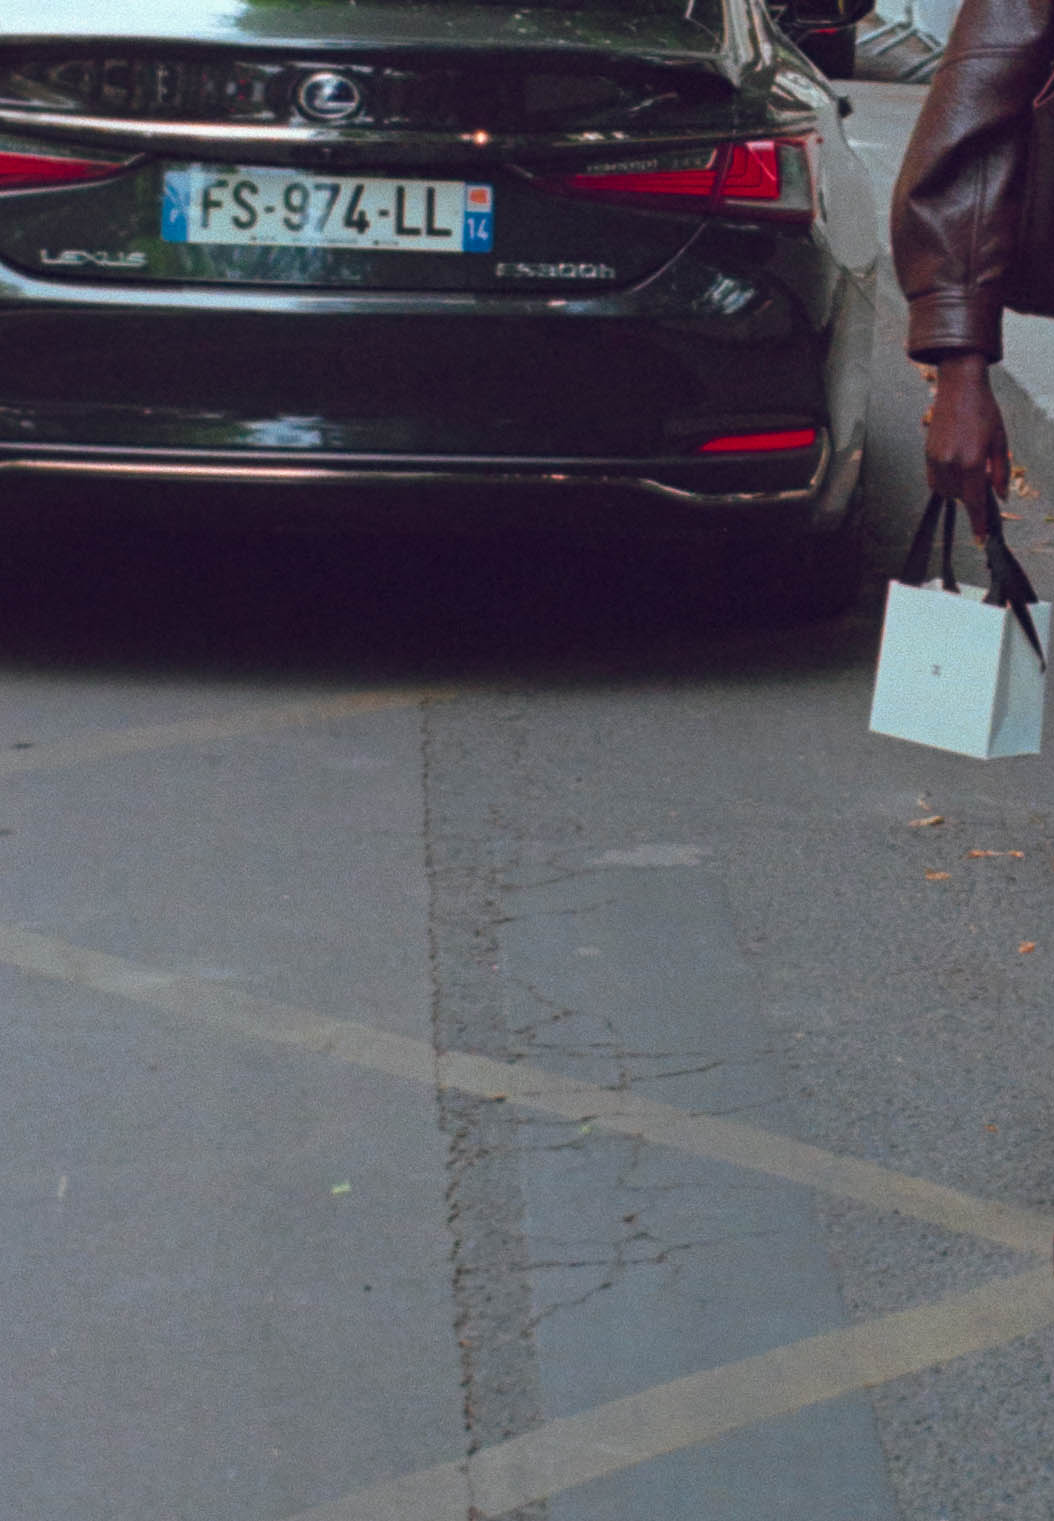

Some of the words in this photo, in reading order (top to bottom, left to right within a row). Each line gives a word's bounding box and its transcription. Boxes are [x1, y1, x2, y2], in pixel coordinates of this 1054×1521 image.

[201, 178, 453, 238] FS-974-LL
[466, 218, 489, 242] 14
[40, 248, 146, 268] LEXUS
